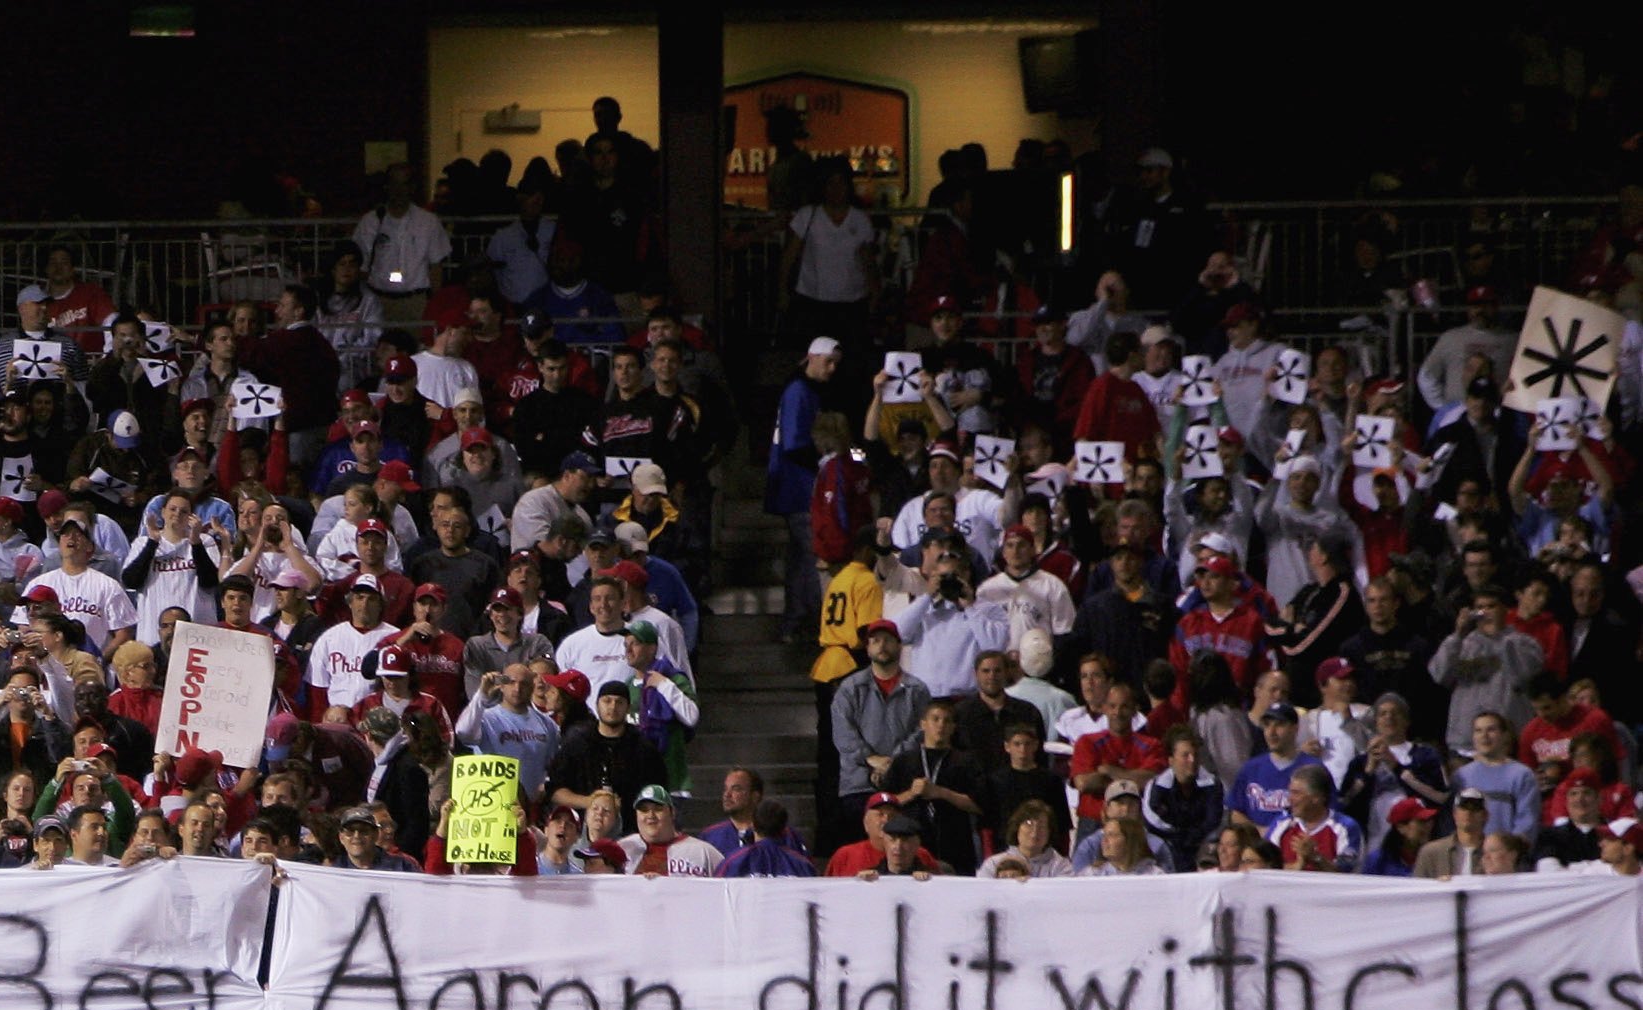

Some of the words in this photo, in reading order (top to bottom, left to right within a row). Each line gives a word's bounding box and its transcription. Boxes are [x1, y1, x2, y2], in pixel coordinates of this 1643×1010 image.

[456, 761, 516, 780] BONDS
[451, 818, 498, 840] NOT
[503, 823, 516, 838] in
